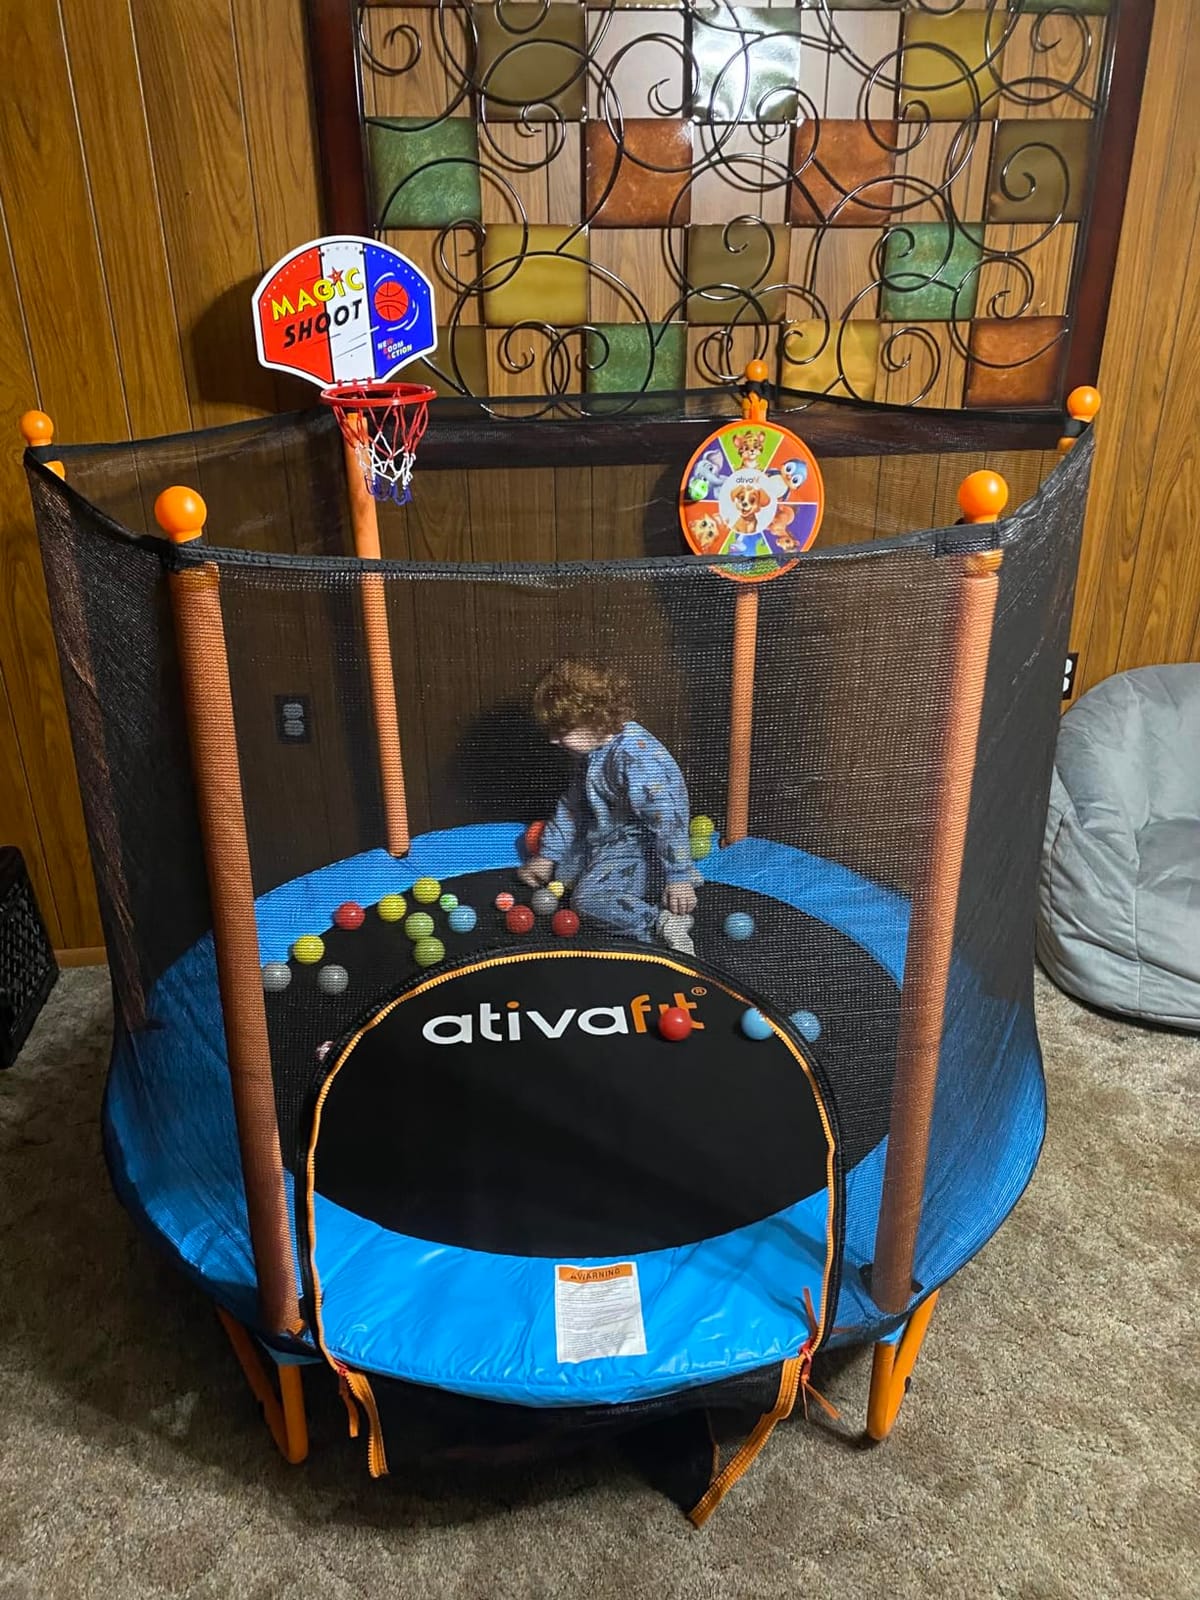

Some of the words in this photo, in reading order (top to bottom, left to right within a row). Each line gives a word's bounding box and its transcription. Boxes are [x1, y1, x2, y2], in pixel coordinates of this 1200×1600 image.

[283, 299, 363, 348] SHOOT
[422, 992, 705, 1045] ativaft
[577, 1268, 621, 1281] WARNING
